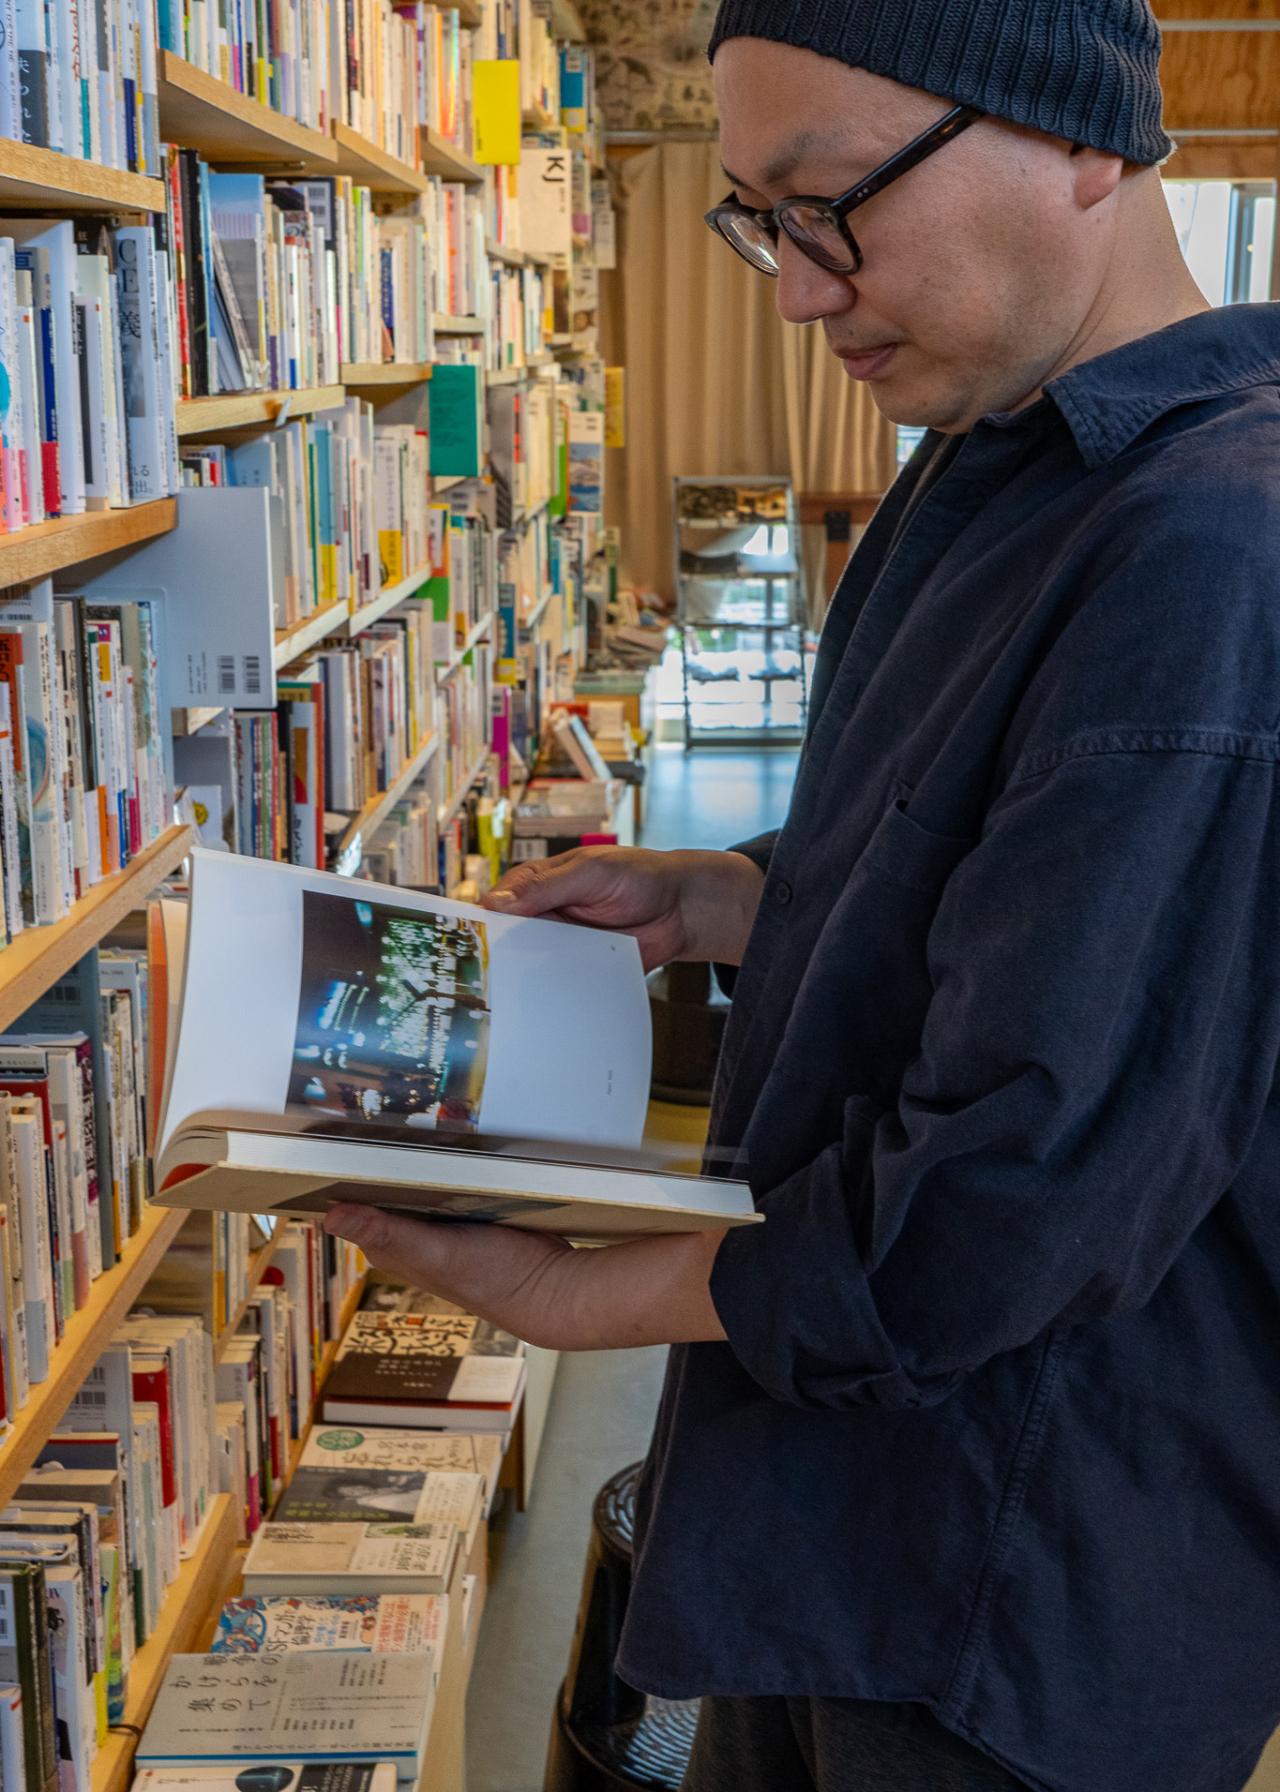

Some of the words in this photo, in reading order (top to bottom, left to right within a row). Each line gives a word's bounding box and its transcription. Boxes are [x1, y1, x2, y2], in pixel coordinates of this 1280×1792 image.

[542, 156, 564, 182] KJ
[168, 1675, 278, 1689] かけらを
[186, 1696, 272, 1712] 集めて
